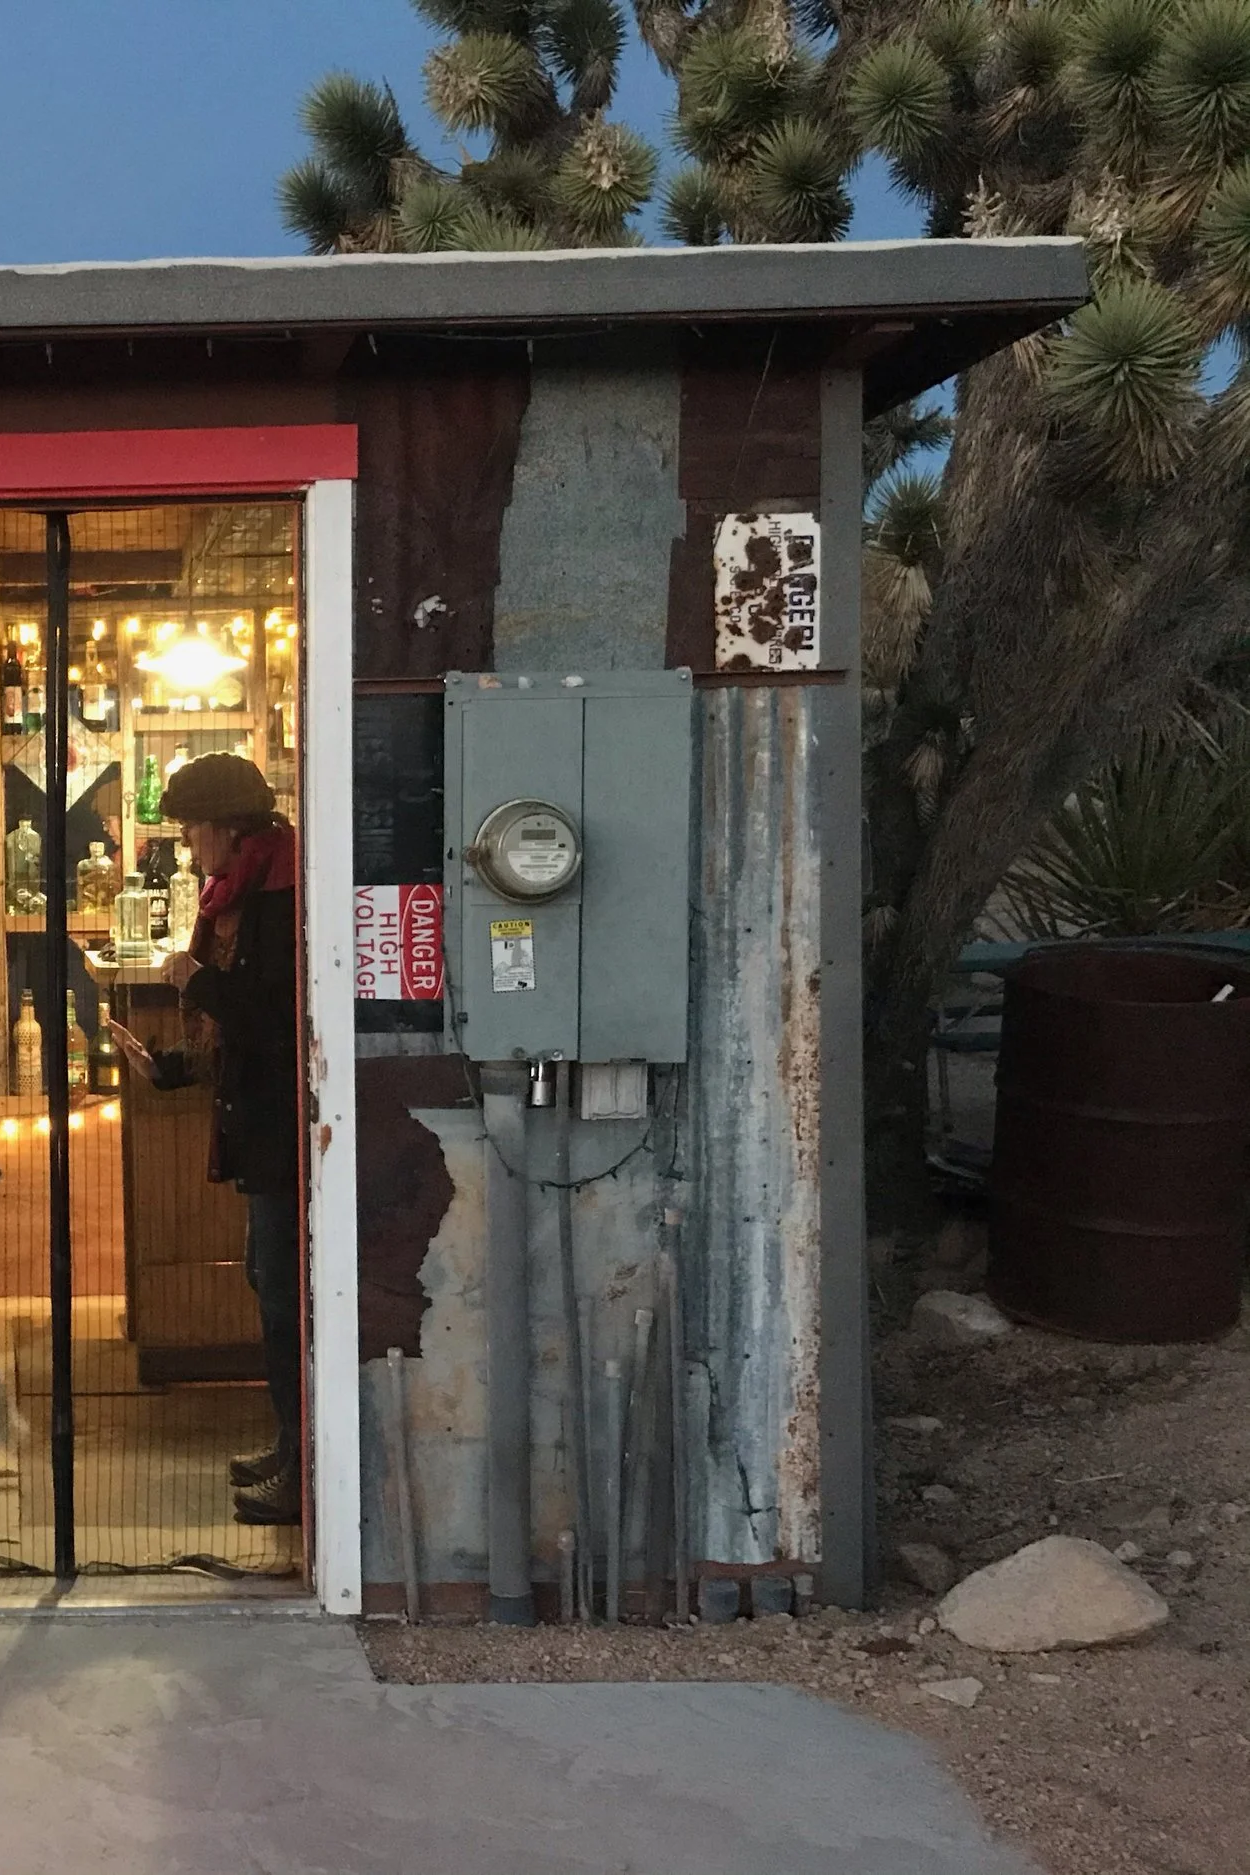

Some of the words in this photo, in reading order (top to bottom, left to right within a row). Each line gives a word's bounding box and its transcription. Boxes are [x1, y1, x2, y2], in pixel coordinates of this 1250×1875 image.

[355, 886, 376, 999] VOLTAGE
[379, 913, 398, 974] HIGH
[411, 900, 436, 989] DANGER
[492, 921, 530, 929] CAUTION
